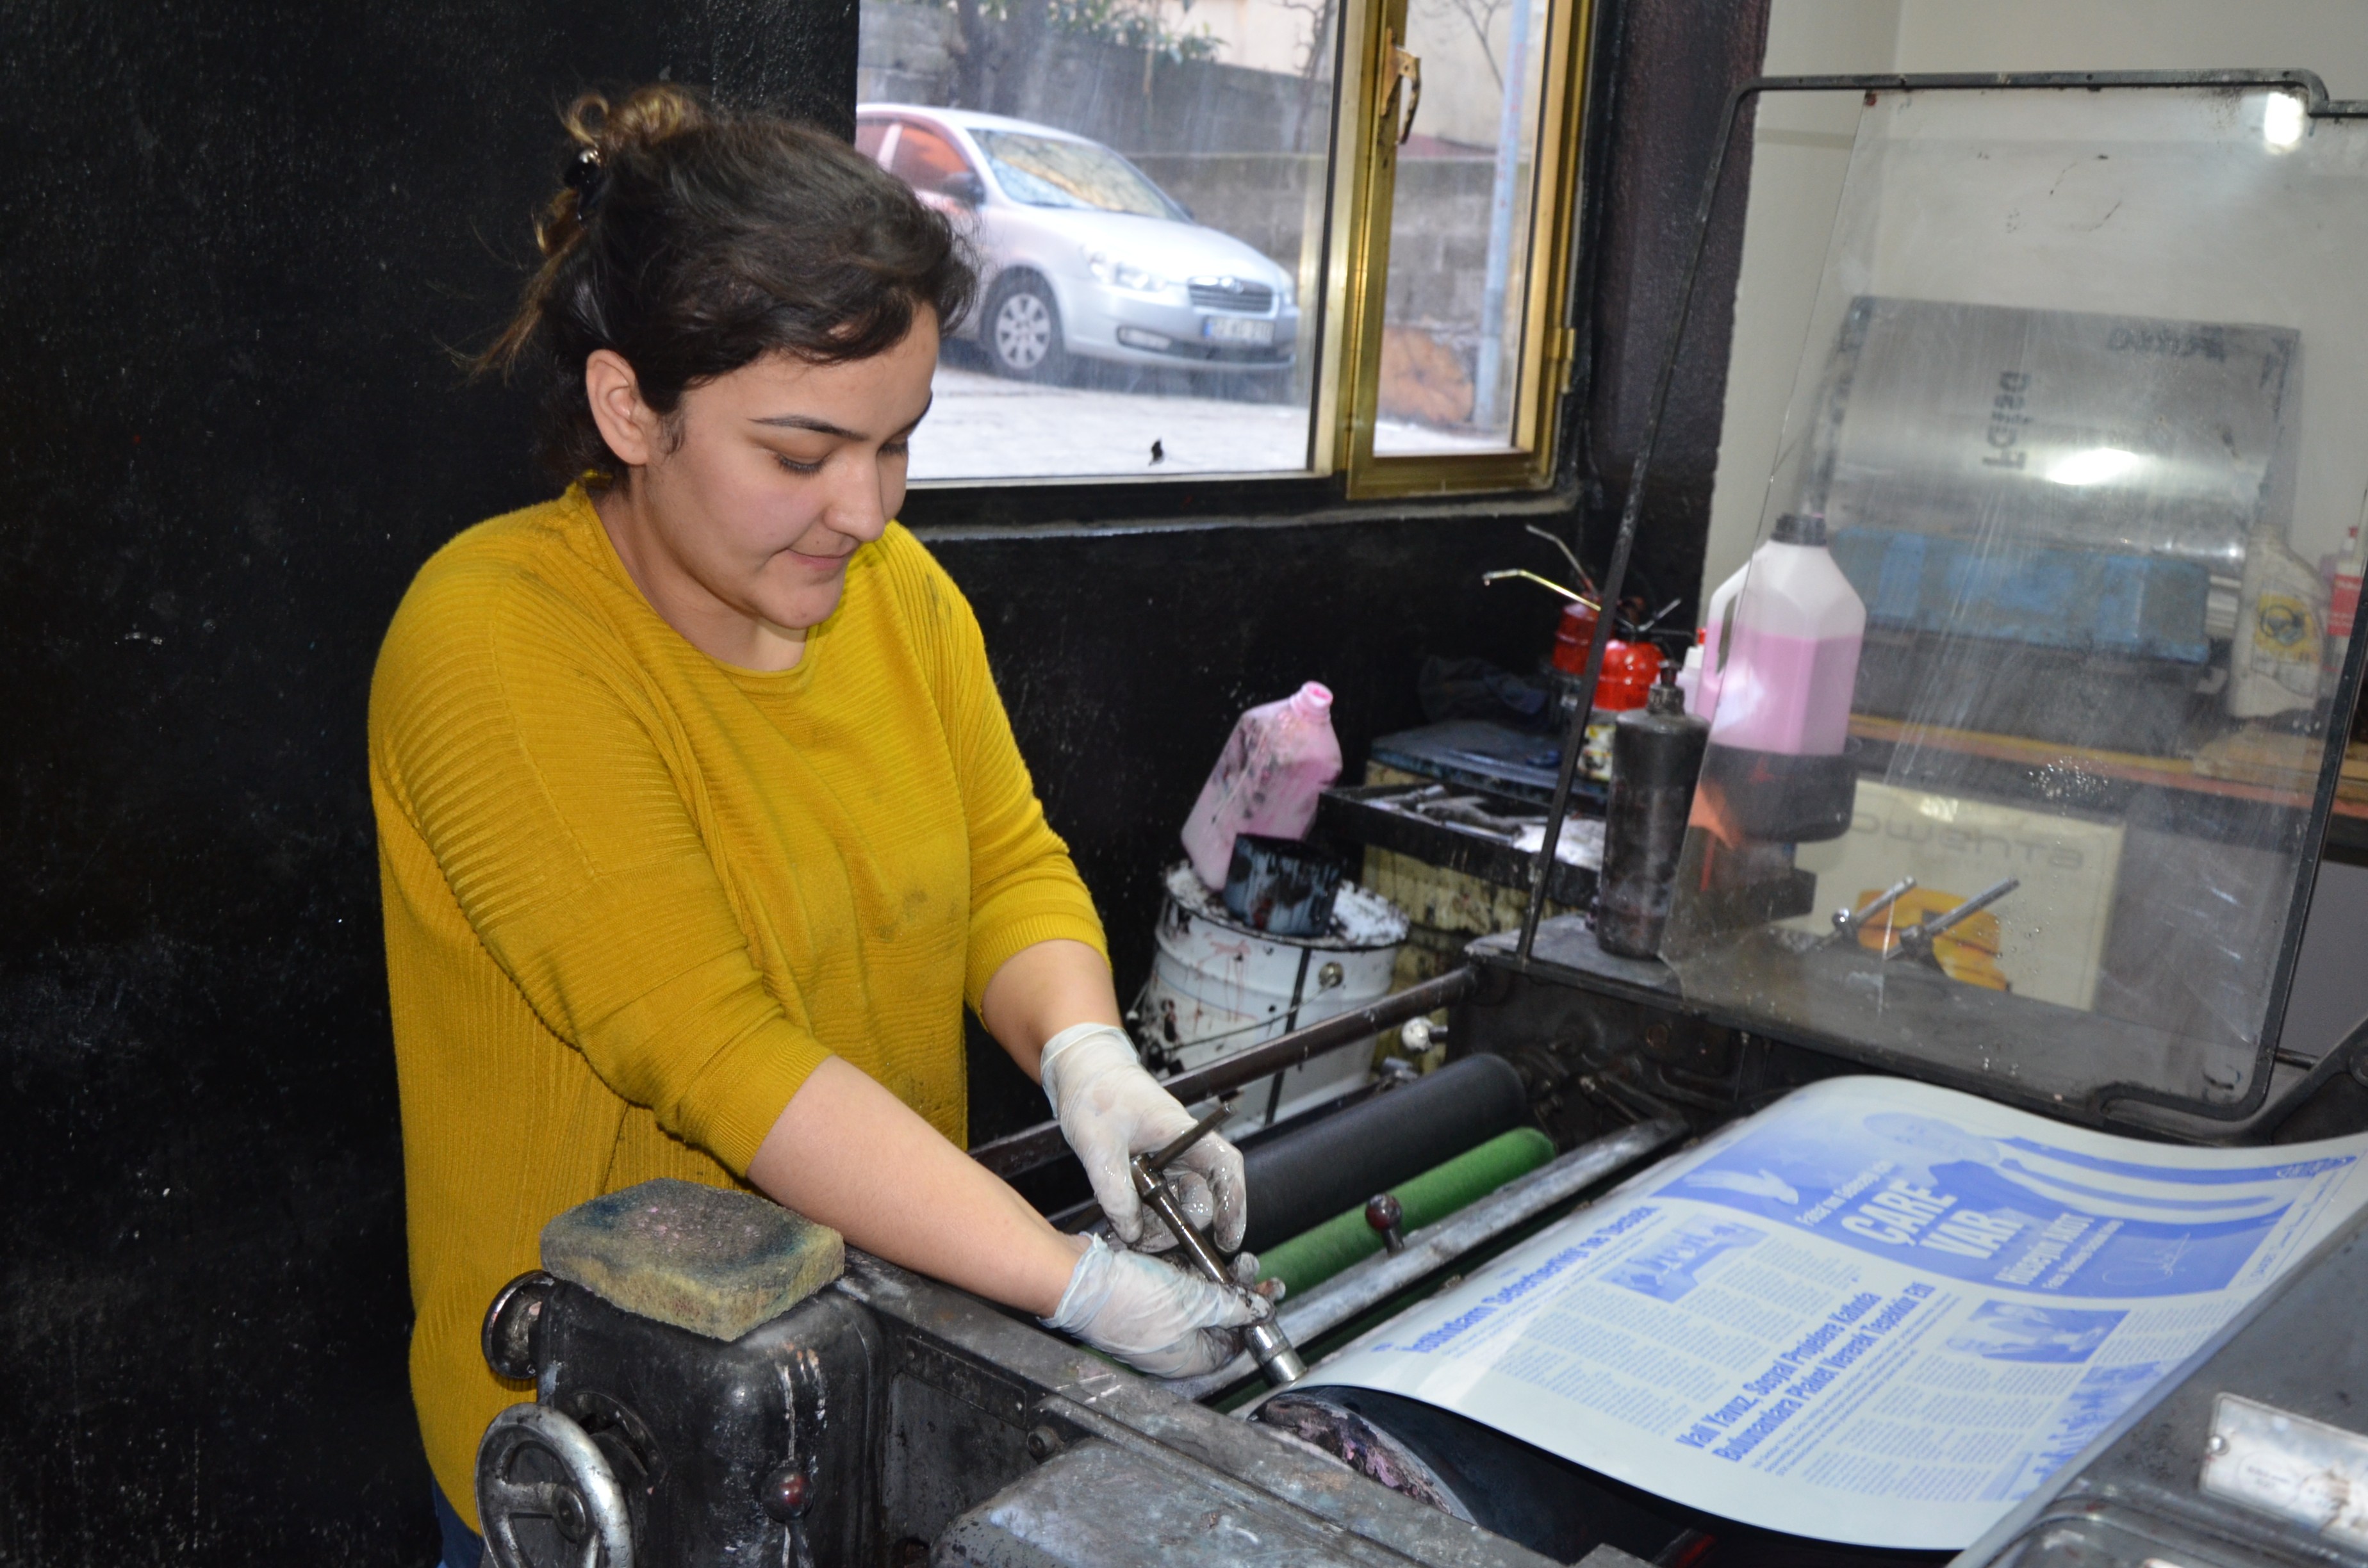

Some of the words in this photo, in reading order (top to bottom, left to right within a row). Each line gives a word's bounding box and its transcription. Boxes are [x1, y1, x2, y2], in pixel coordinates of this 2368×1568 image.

[1852, 812, 2084, 871] owenta
[1841, 1179, 1959, 1247] ÇARE
[1919, 1209, 2025, 1260] VAR
[1675, 1423, 1722, 1449] Vali
[1700, 1394, 1764, 1428] Yavuz,
[1741, 1359, 1798, 1396] Sosyal
[1779, 1322, 1846, 1366] Projelere
[1784, 1365, 1840, 1401] Plaket
[1818, 1332, 1880, 1370] Vererek
